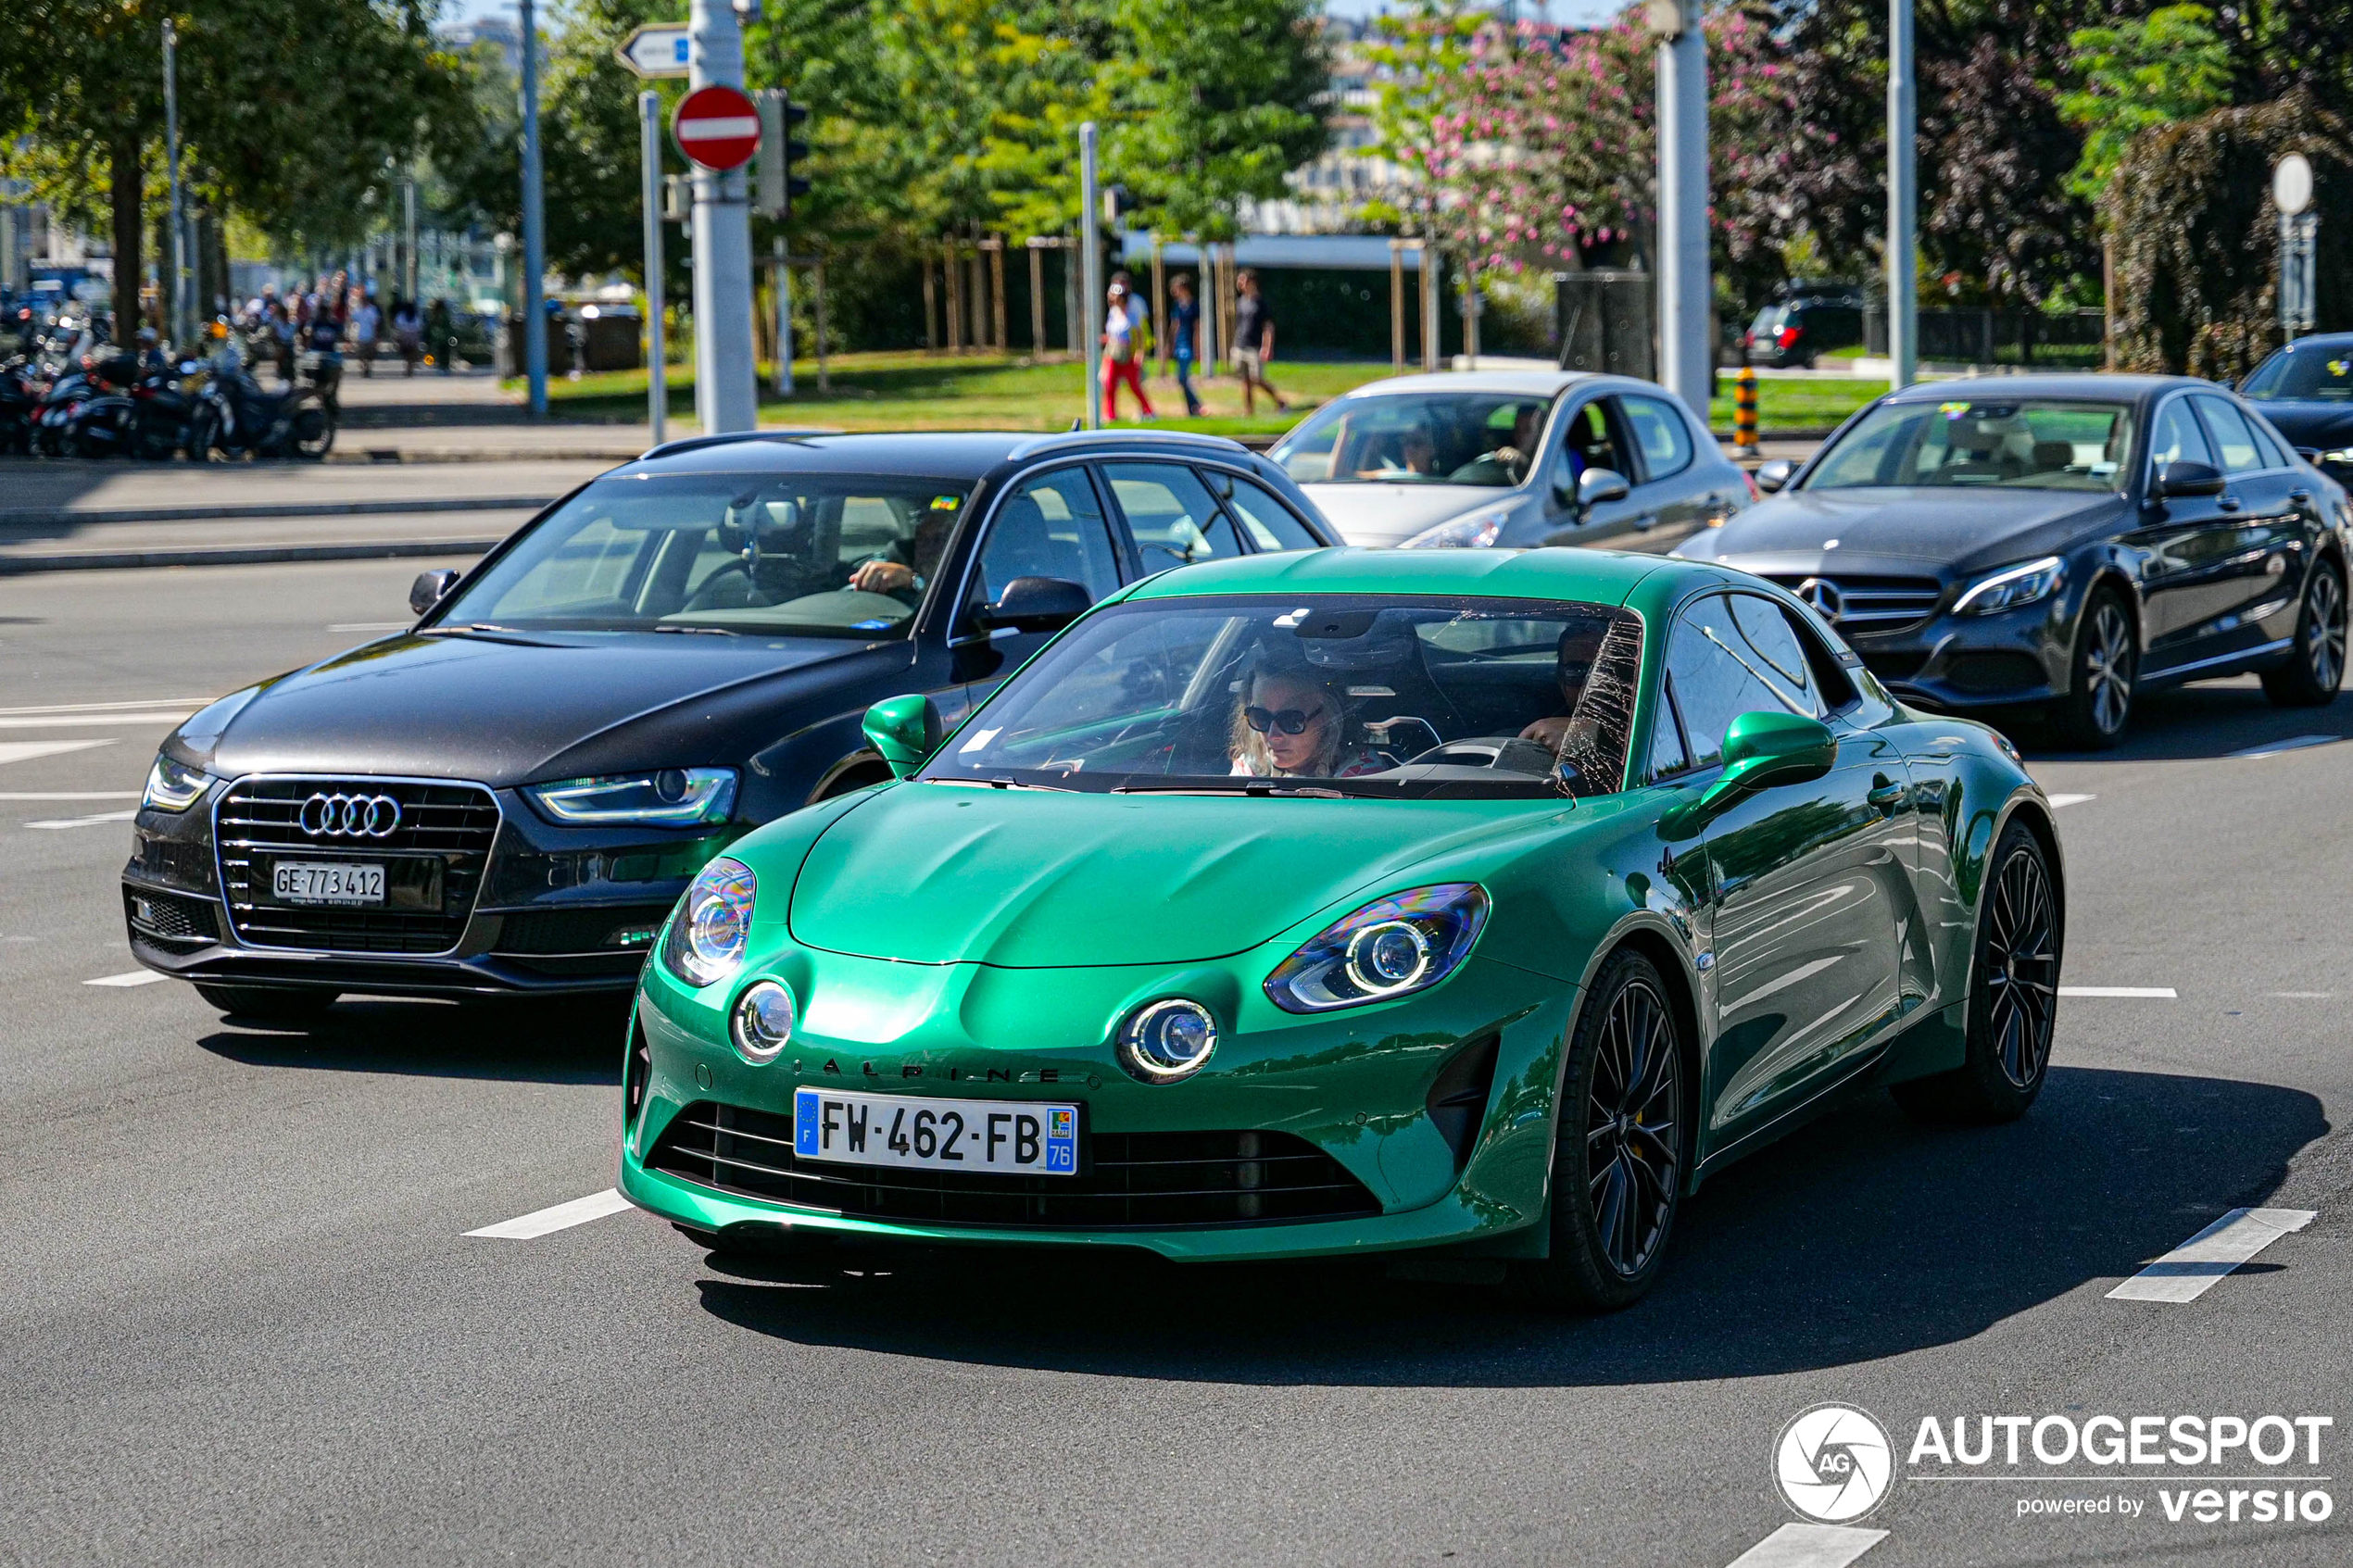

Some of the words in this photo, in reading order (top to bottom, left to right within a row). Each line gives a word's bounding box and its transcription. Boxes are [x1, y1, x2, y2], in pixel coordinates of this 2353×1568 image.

[822, 1058, 1059, 1083] ALPINE
[803, 1130, 811, 1143] F
[1050, 1145, 1071, 1166] 76
